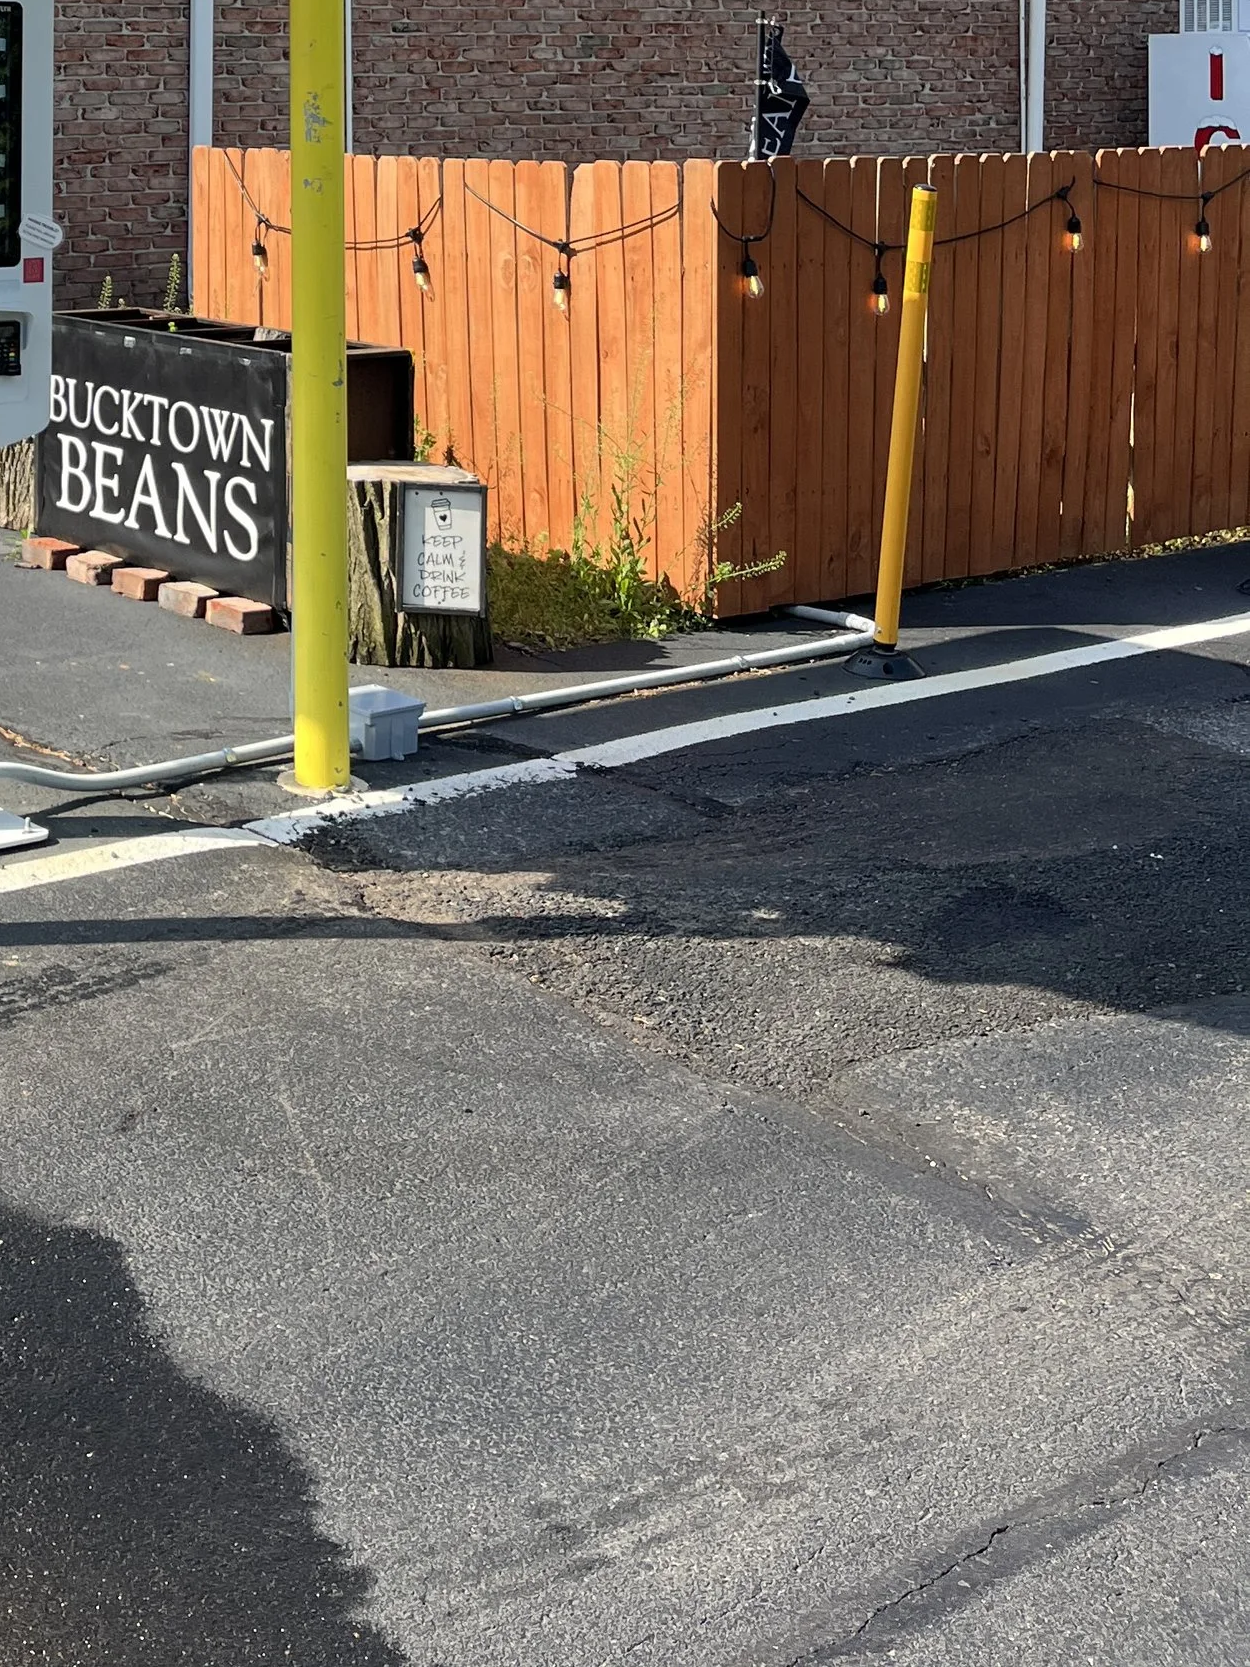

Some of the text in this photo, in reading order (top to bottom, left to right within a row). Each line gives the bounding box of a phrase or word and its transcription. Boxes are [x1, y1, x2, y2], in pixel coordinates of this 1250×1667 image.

[50, 374, 275, 472] BUCKTOWN
[55, 432, 259, 562] BEANS
[421, 534, 463, 550] KEEP
[417, 551, 455, 567] CALM
[418, 569, 467, 584] DRINK
[413, 583, 470, 600] COFFEE
